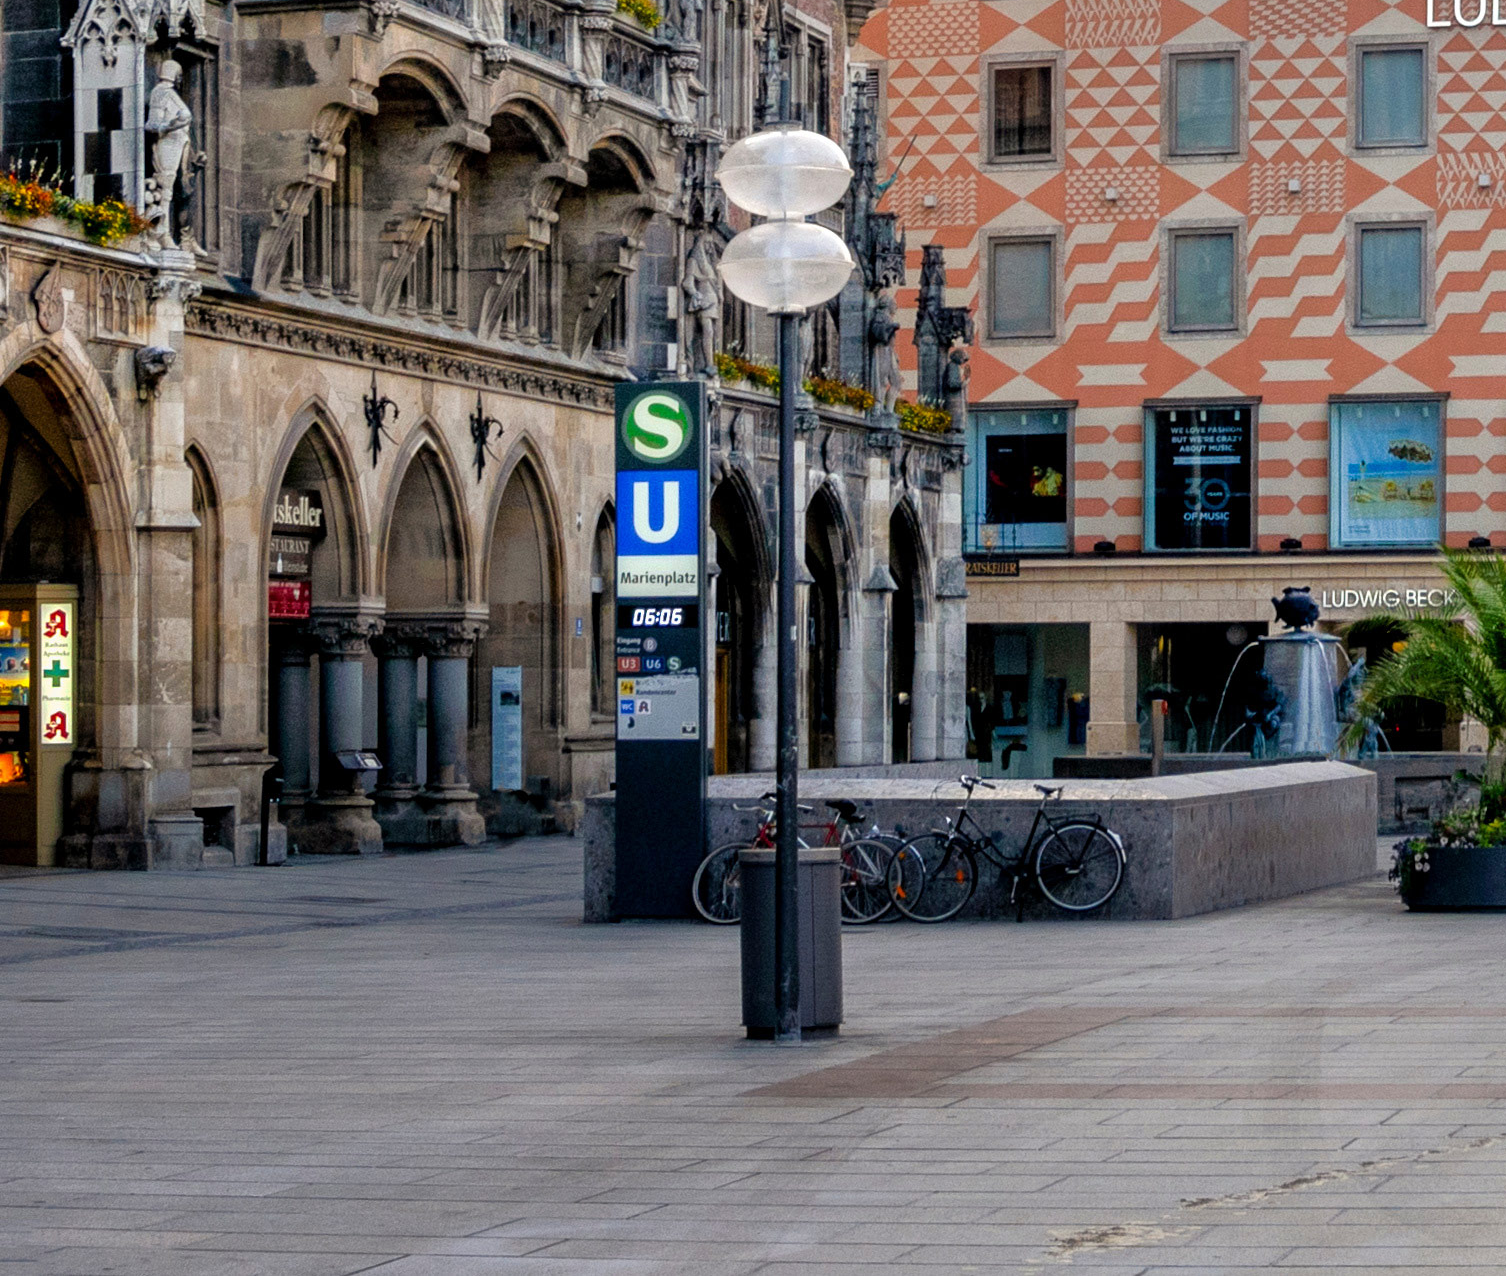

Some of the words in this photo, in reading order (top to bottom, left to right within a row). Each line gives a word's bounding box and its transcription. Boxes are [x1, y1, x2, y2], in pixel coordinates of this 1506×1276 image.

[633, 395, 683, 459] S
[1184, 478, 1230, 510] 30
[633, 481, 680, 544] U
[1183, 512, 1198, 520] OF
[1200, 512, 1230, 520] MUSIC
[620, 571, 696, 587] Marienplatz
[1323, 590, 1400, 608] LUDWIG
[1406, 589, 1457, 608] BECK
[632, 608, 683, 627] 06:06
[621, 659, 637, 669] U3
[646, 659, 661, 669] U6
